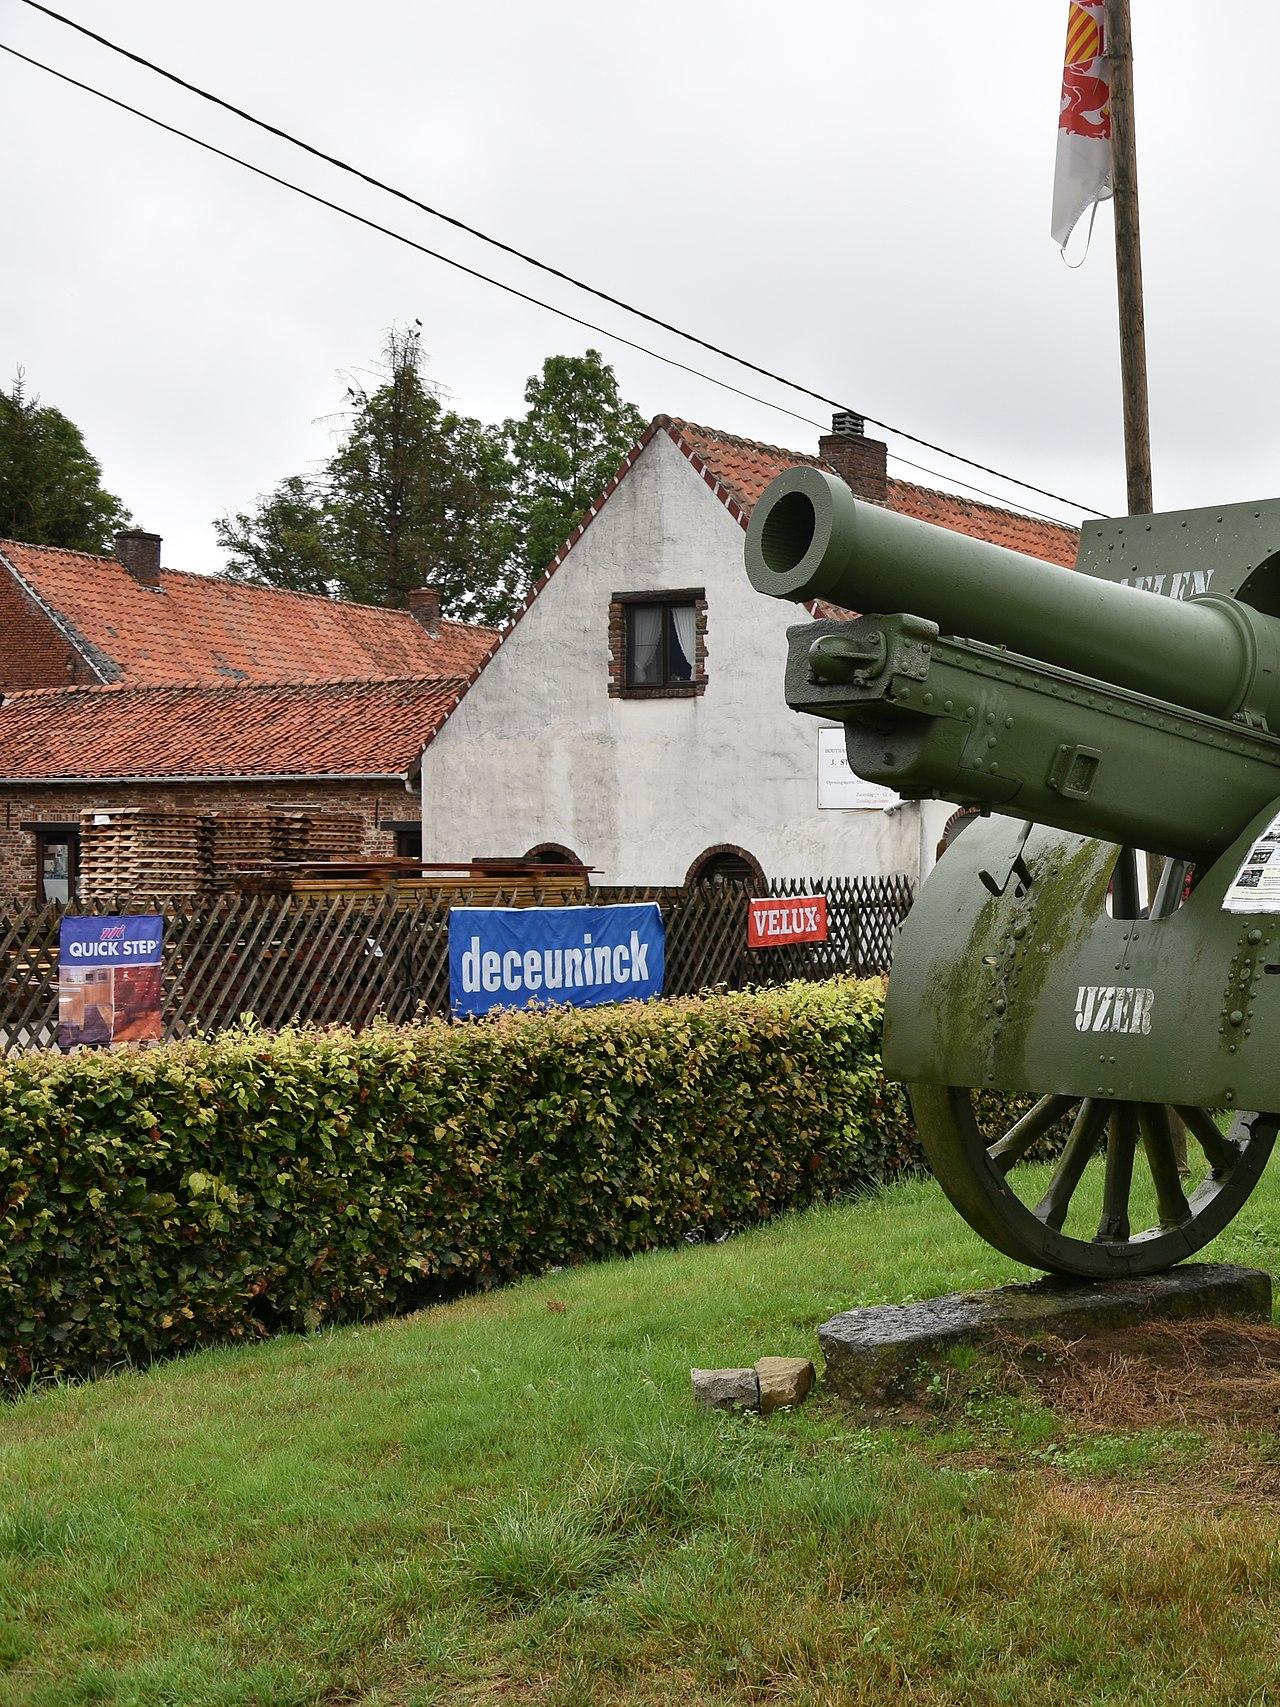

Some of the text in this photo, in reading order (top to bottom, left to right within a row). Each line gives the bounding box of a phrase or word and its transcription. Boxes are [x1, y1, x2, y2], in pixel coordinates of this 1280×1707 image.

[69, 942, 120, 957] QUICK
[461, 930, 649, 993] deceuninck
[1074, 986, 1155, 1035] IJZER
